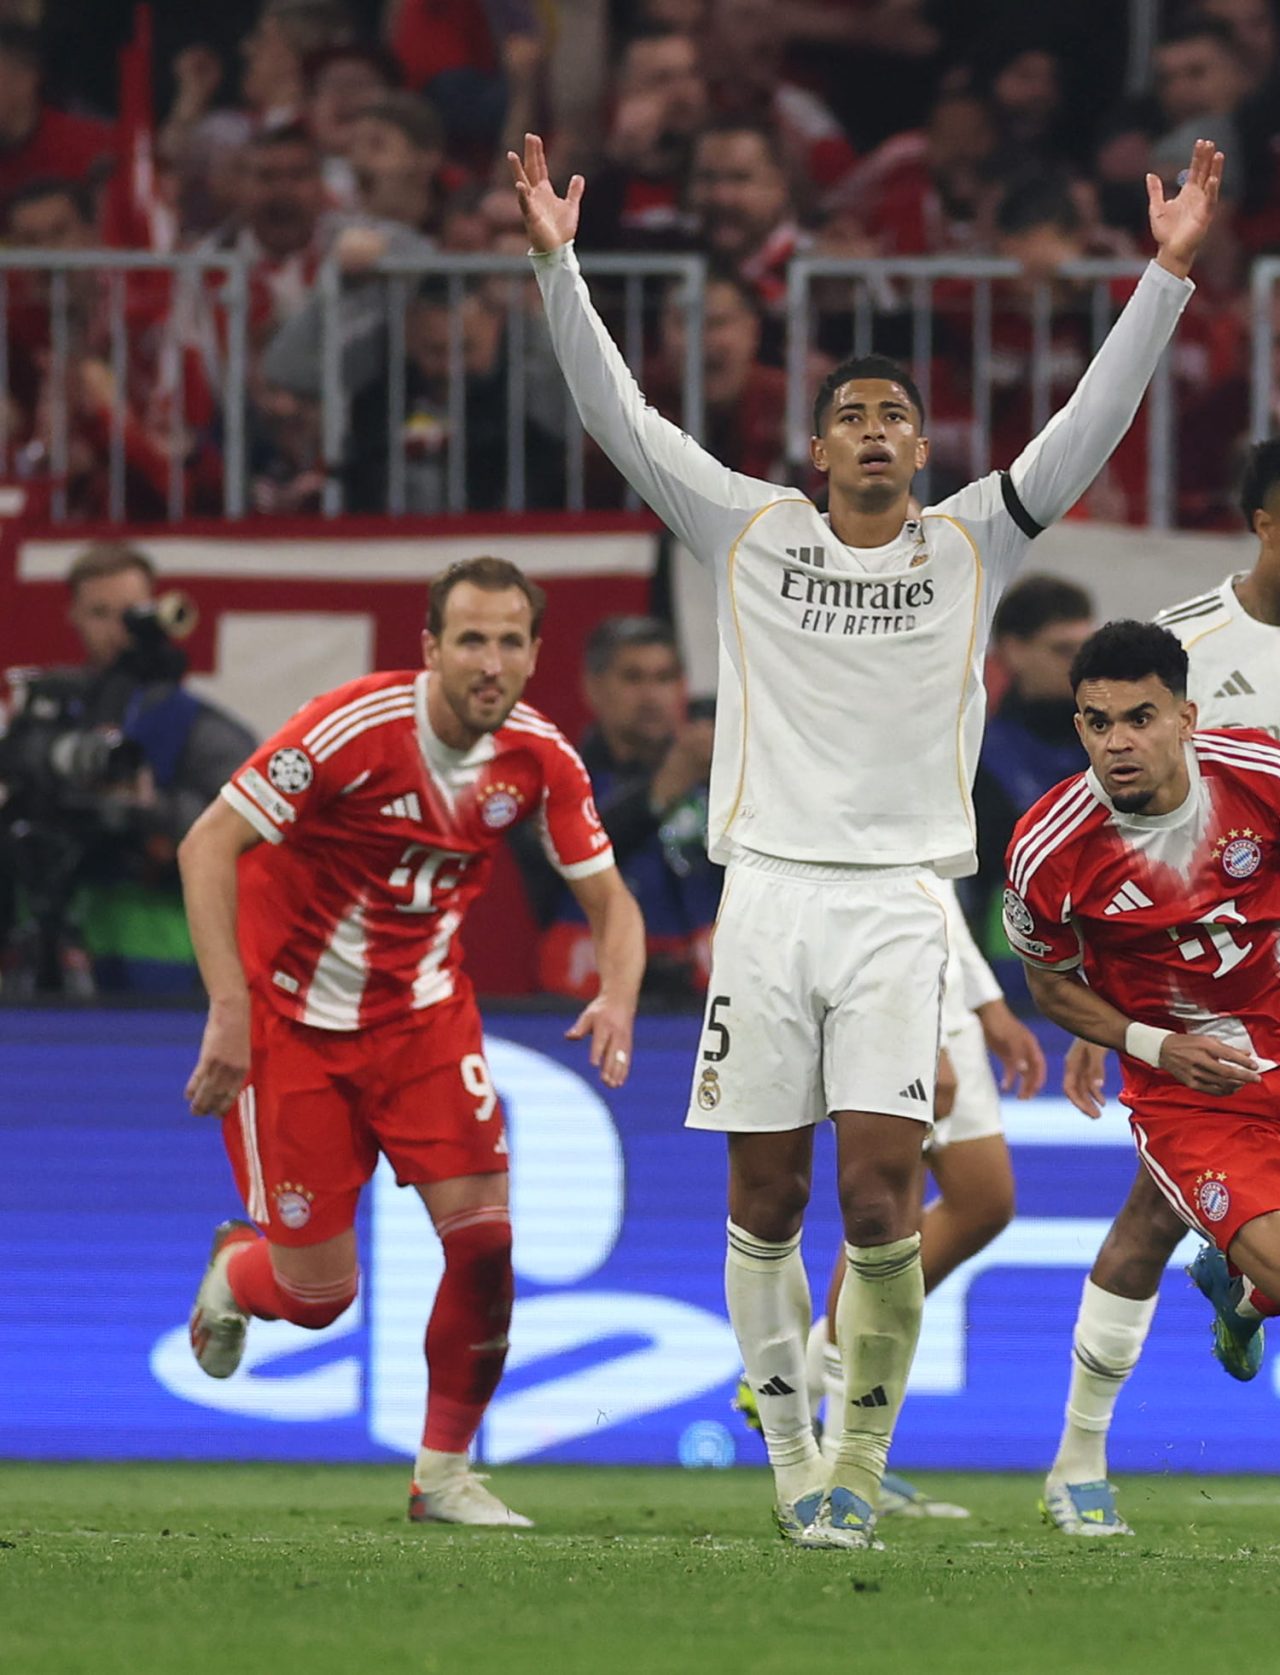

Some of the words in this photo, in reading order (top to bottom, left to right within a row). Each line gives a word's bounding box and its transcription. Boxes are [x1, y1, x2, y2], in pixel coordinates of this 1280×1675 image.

[780, 568, 934, 610] Emirates
[704, 996, 731, 1062] 5
[461, 1053, 498, 1121] 9
